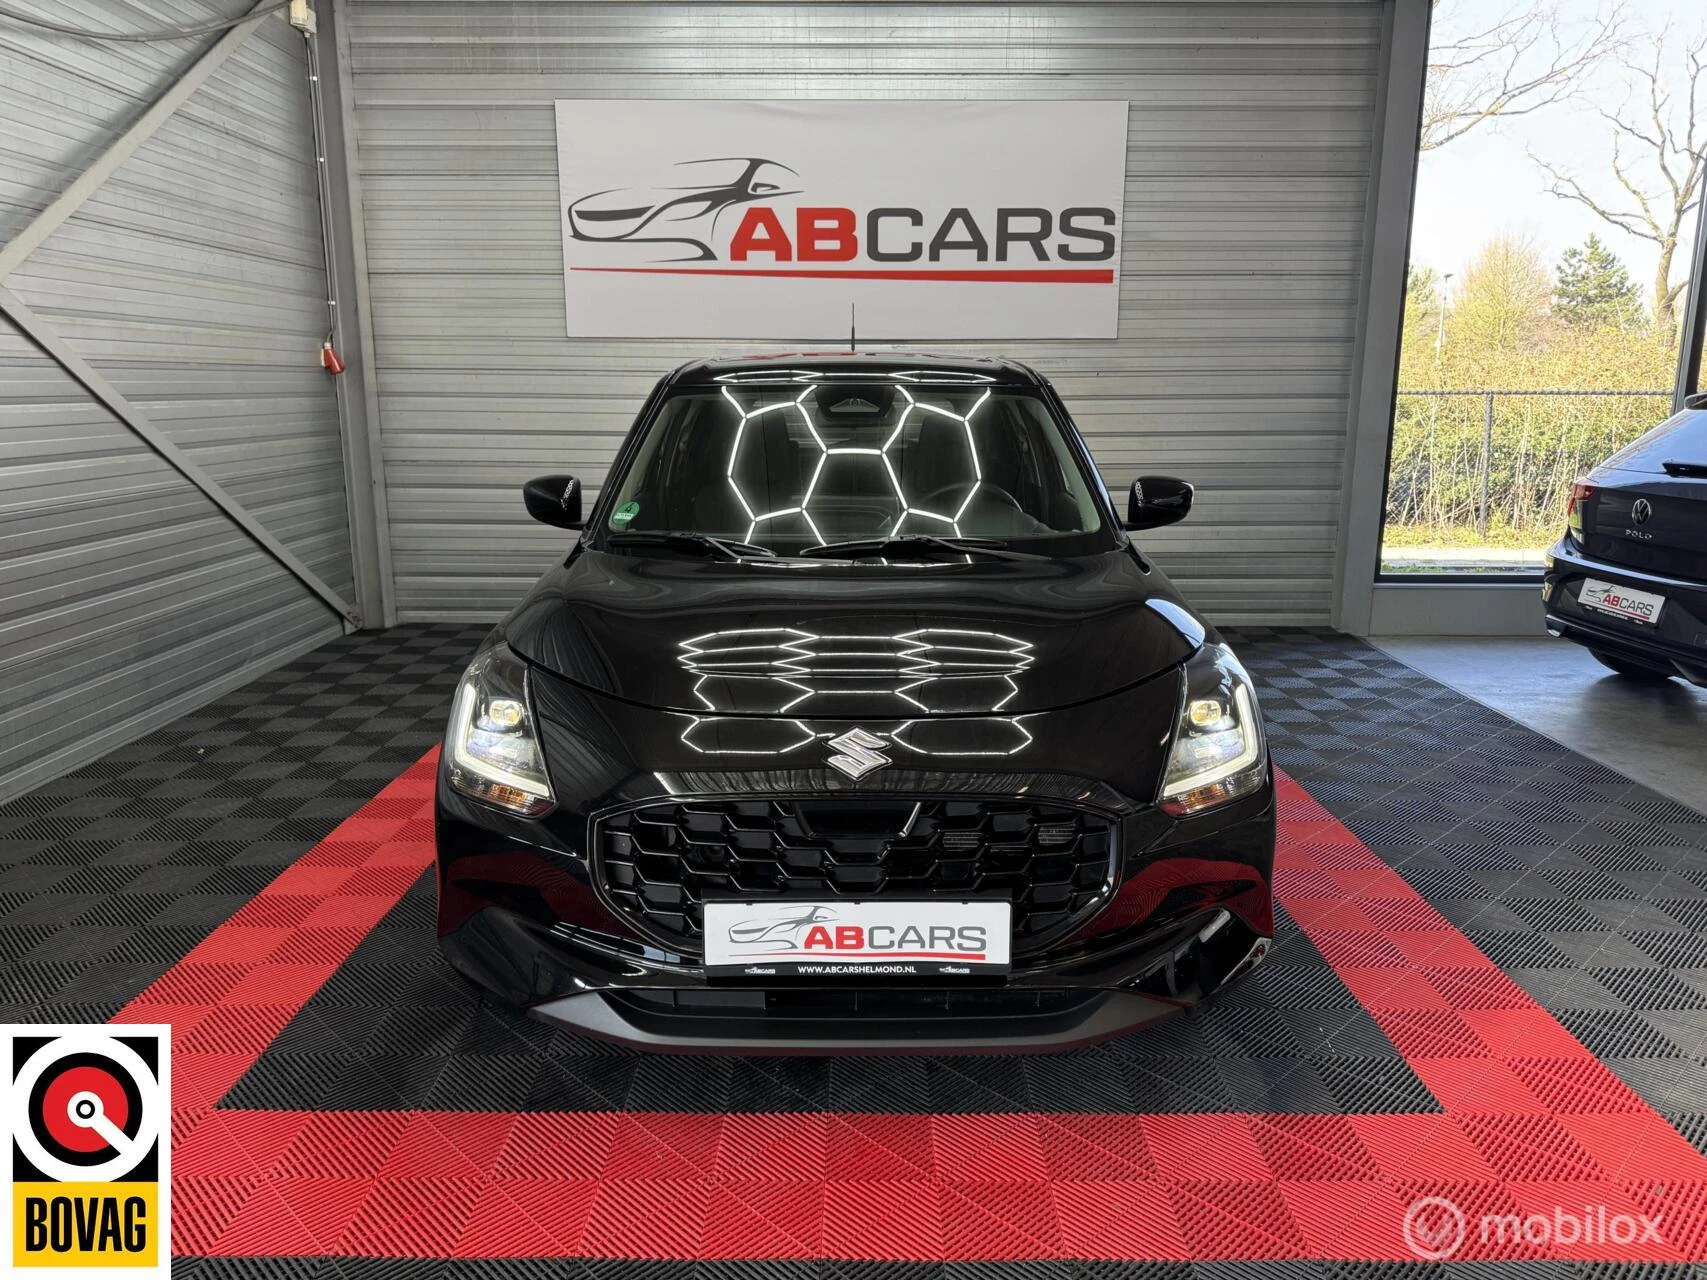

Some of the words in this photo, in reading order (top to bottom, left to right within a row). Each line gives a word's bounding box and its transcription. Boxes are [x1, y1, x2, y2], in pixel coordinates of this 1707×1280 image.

[730, 206, 1116, 263] ABCARS
[1626, 530, 1652, 540] POLO
[1602, 594, 1654, 616] ABCARS
[804, 926, 987, 951] ABCARS
[798, 966, 917, 974] WWW.ABCARSHELMOND.NL
